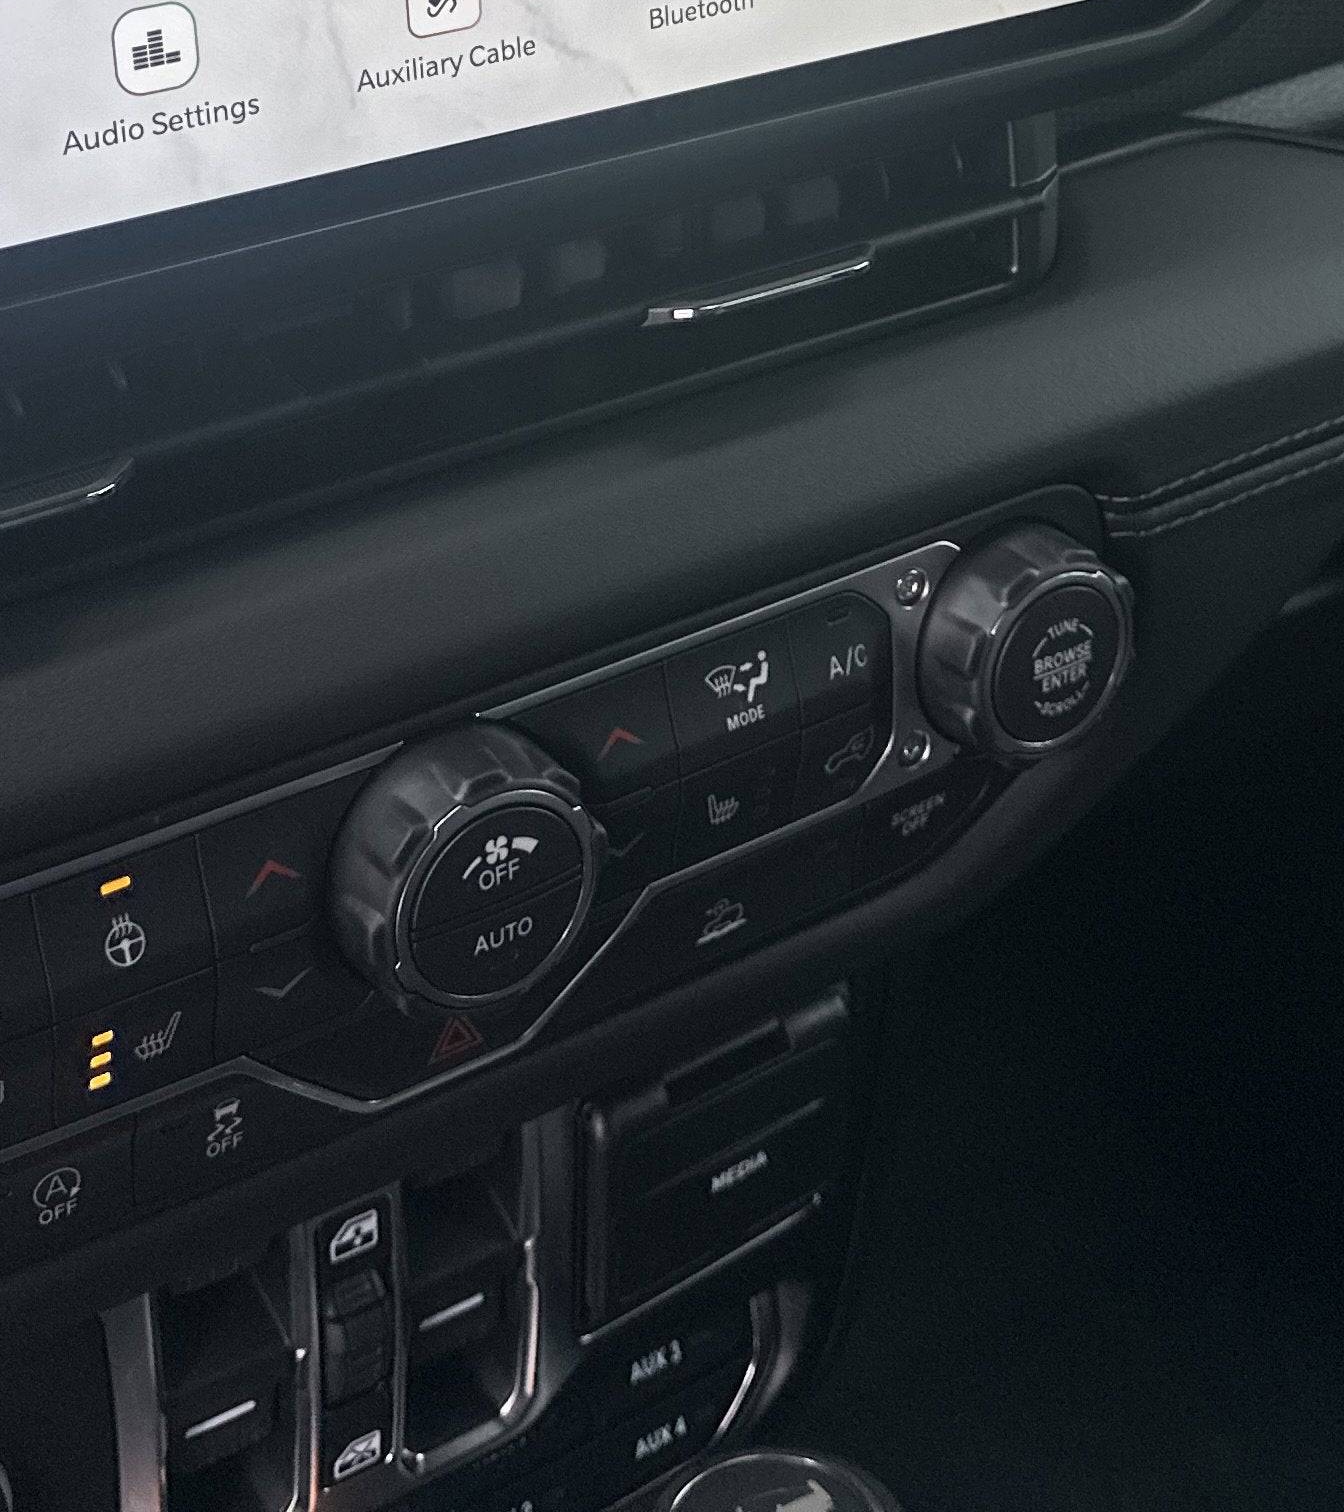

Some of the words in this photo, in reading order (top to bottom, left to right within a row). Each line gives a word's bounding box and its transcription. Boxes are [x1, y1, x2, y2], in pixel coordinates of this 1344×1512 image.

[357, 52, 463, 93] Auxiliary
[470, 35, 537, 69] Cable
[62, 120, 145, 156] Audio
[151, 96, 261, 136] Settings
[829, 643, 868, 681] A/C
[1033, 639, 1092, 675] BROWSE
[1042, 662, 1087, 693] ENTER
[726, 703, 766, 732] MODE
[478, 857, 520, 891] OFF
[473, 915, 533, 956] AUTO
[205, 1132, 244, 1159] OFF
[711, 1150, 768, 1193] MEDIA
[37, 1199, 79, 1226] OFF
[631, 1345, 667, 1385] AUX
[636, 1423, 673, 1458] AUX
